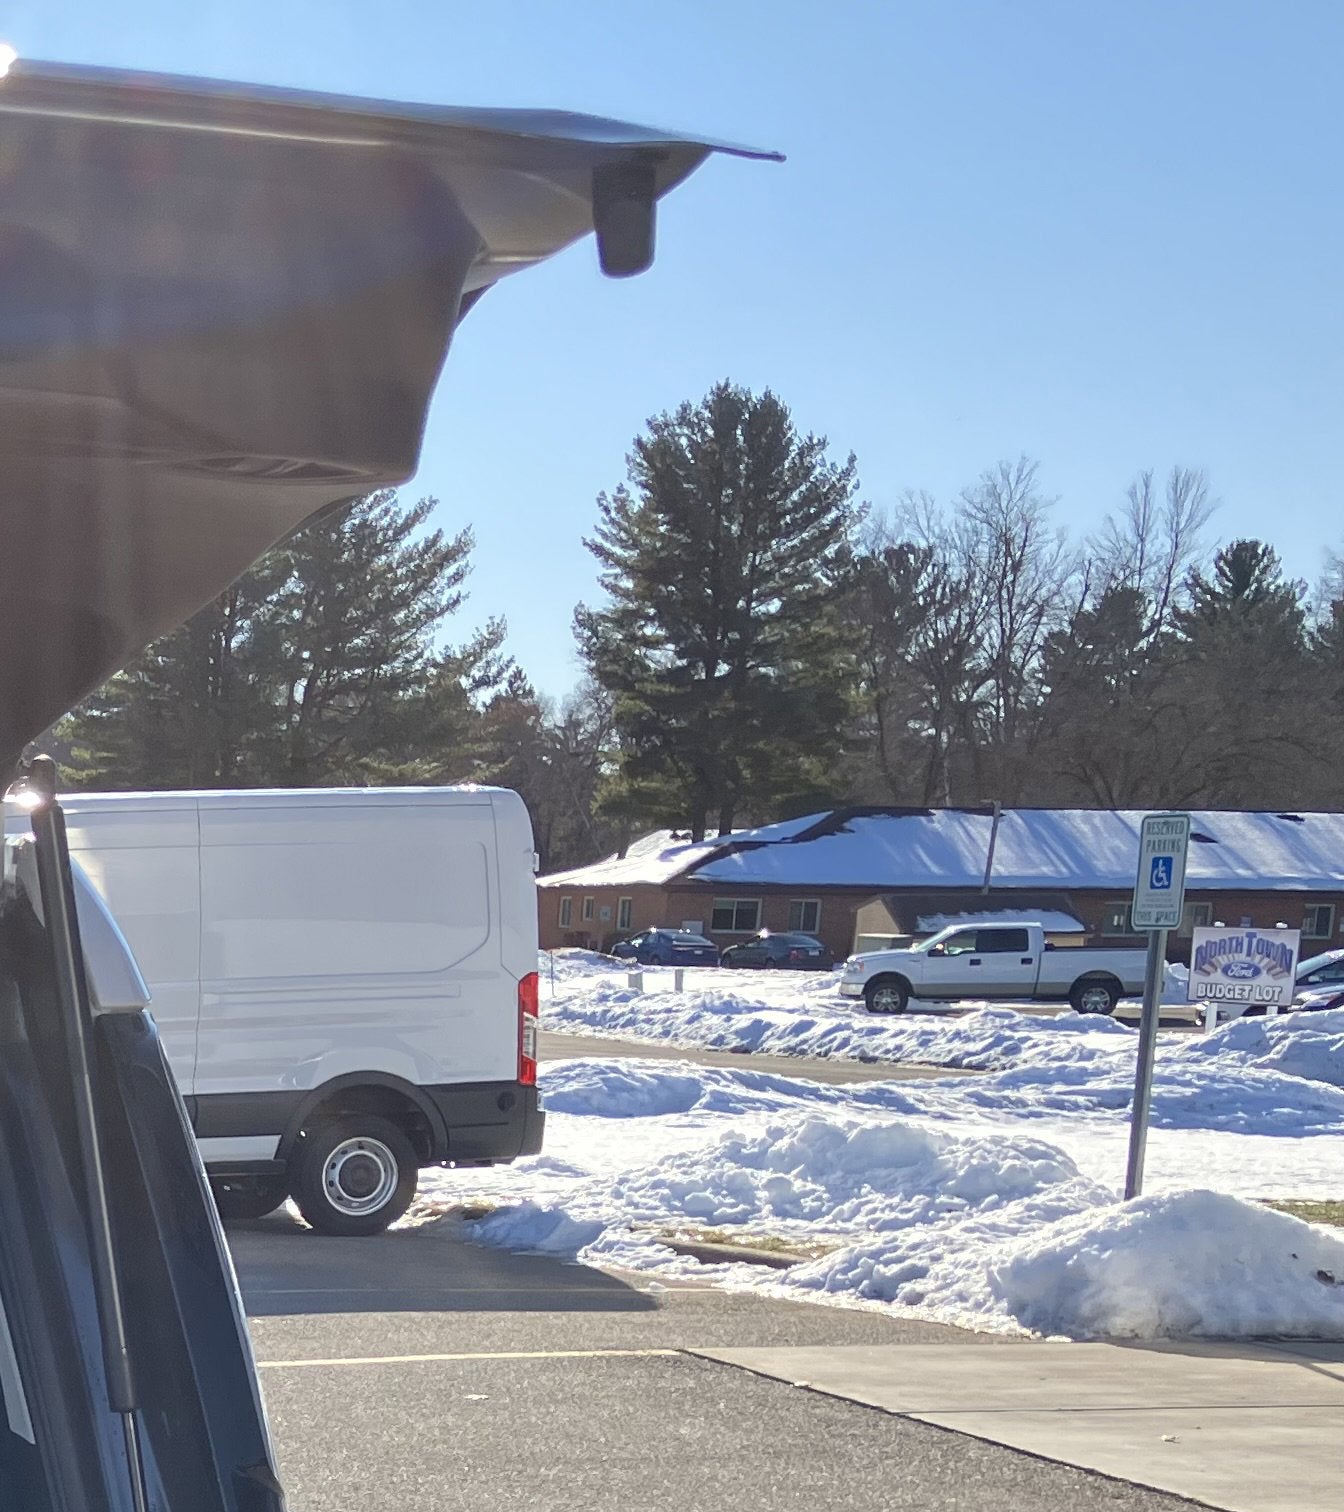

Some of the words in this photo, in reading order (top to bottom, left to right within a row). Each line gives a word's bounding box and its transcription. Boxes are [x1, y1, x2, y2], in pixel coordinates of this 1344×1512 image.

[1146, 820, 1185, 835] RESERVED
[1145, 839, 1182, 853] PARKING
[1227, 963, 1255, 978] Ford
[1196, 982, 1253, 1000] BUDGET
[1255, 985, 1283, 1002] LOT
